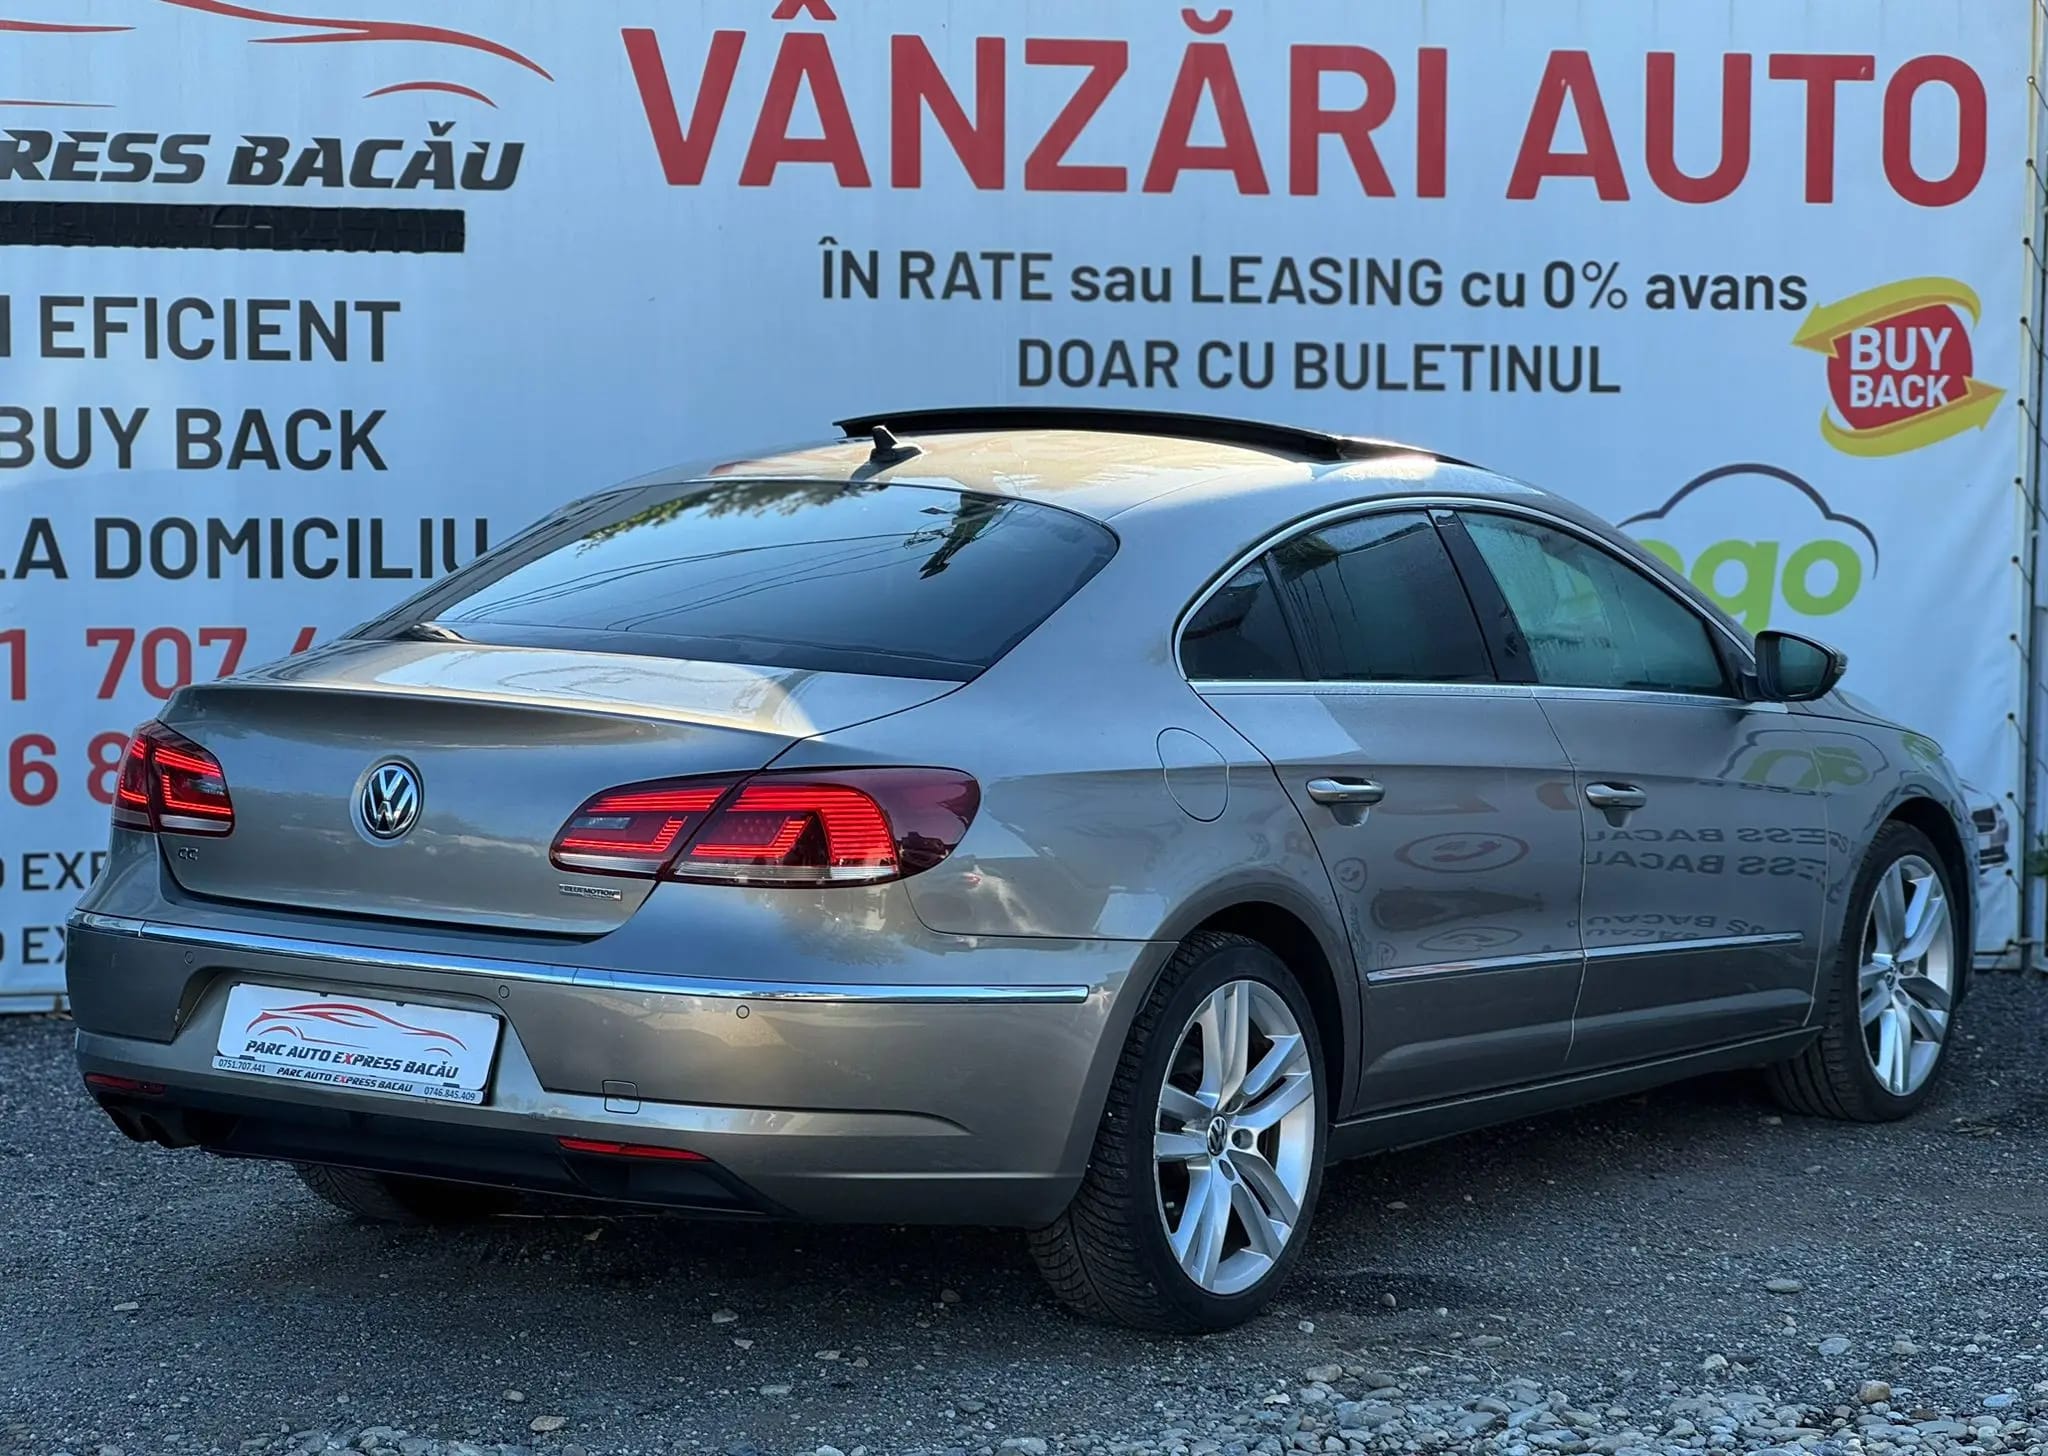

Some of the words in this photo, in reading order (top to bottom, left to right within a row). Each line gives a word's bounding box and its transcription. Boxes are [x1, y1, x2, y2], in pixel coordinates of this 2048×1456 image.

[622, 0, 1448, 199] VÂNZĂRI
[1506, 50, 1988, 208] AUTO
[0, 129, 211, 184] RESS
[228, 121, 525, 191] BACĂU
[819, 237, 879, 300] ÎN
[901, 251, 1053, 302] RATE
[1071, 265, 1172, 303] sau
[1193, 255, 1443, 308] LEASING
[1461, 272, 1526, 308] cu
[1544, 261, 1628, 311] 0%
[1646, 274, 1807, 311] avans
[40, 296, 401, 363] EFICIENT
[1850, 326, 1952, 371] BUY
[1019, 339, 1180, 390] DOAR
[1198, 341, 1275, 391] CU
[1295, 342, 1621, 394] BULETINUL
[1850, 374, 1951, 408] BACK
[0, 406, 150, 471] BUY
[177, 408, 388, 472] BACK
[0, 517, 69, 580] A
[95, 517, 488, 581] DOMICILIU
[87, 628, 248, 700] 707
[10, 735, 59, 807] 6
[218, 1059, 266, 1073] 0751.707.441
[276, 1067, 304, 1078] PARC
[303, 1071, 333, 1081] AUTO
[332, 1074, 378, 1087] EXPRESS
[377, 1081, 413, 1093] BACAU
[424, 1086, 476, 1101] 0746.845.409
[245, 1040, 287, 1056] PARC
[286, 1045, 332, 1062] AUTO
[332, 1051, 403, 1071] EXPRESS
[403, 1060, 459, 1079] BACĂU
